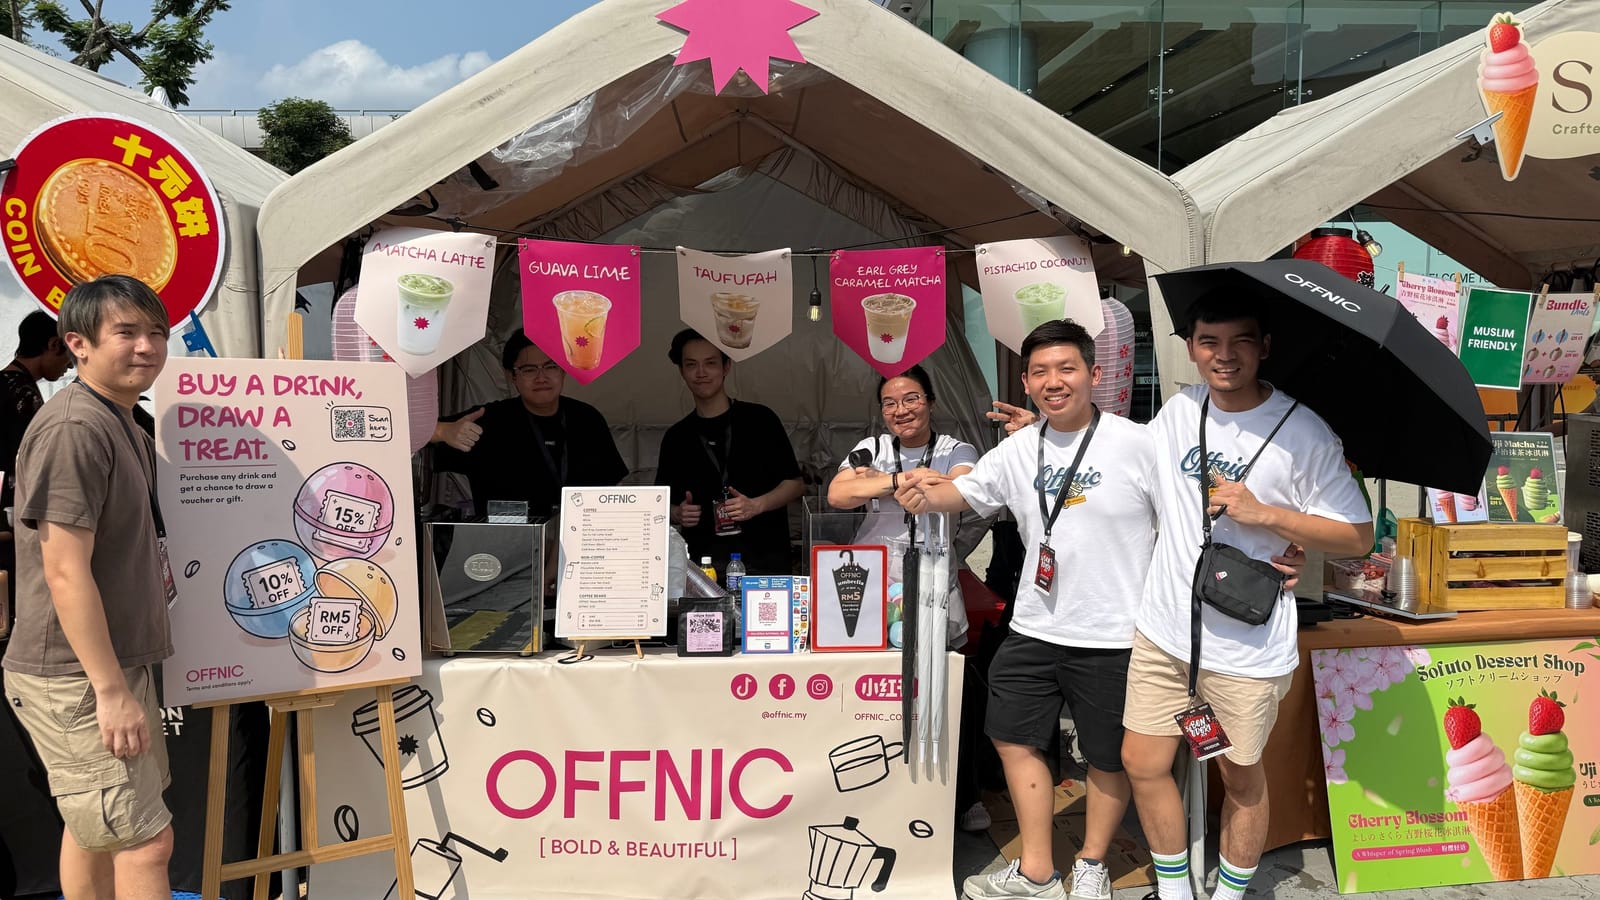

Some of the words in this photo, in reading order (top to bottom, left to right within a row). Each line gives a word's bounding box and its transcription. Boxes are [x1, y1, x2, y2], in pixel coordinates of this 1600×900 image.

[5, 197, 42, 277] COIN
[372, 242, 437, 262] MATCHA
[441, 253, 486, 269] LATTE
[528, 260, 579, 278] GUAVA
[583, 265, 631, 281] LIME
[856, 266, 886, 276] EARL
[889, 264, 918, 276] GREY
[984, 261, 1037, 276] PISTACHIO
[1040, 257, 1088, 269] COCONUT
[693, 266, 778, 287] TAUFUFAH
[834, 276, 891, 289] CARAMEL
[894, 275, 941, 288] MATCHA
[1284, 273, 1361, 313] OFFNIC
[1546, 299, 1588, 311] Bundle
[1473, 326, 1515, 339] MUSLIM
[1467, 338, 1517, 352] FRIENDLY
[177, 373, 237, 396] BUY
[245, 374, 265, 396] A
[273, 374, 363, 400] DRINK,
[178, 405, 263, 428] DRAW
[272, 406, 292, 427] A
[368, 414, 389, 422] Scan
[369, 423, 387, 431] here
[179, 438, 268, 461] TREAT.
[1504, 440, 1536, 448] Matcha
[179, 473, 219, 482] Purchase
[220, 474, 237, 483] any
[238, 472, 258, 480] drink
[259, 471, 277, 479] and
[180, 484, 194, 493] get
[203, 483, 233, 491] chance
[235, 483, 244, 491] to
[245, 482, 266, 490] draw
[180, 496, 214, 504] voucher
[227, 494, 244, 504] gift.
[598, 494, 637, 504] OFFNIC
[334, 506, 365, 526] 15%
[335, 523, 357, 533] OFF
[259, 572, 293, 594] 10%
[837, 579, 864, 587] umbrella
[268, 589, 290, 603] OFF
[841, 591, 861, 601] RM5
[320, 610, 351, 625] RM5
[322, 625, 344, 635] OFF
[186, 664, 244, 682] OFFNIC
[1416, 657, 1472, 683] Sofuto
[1475, 653, 1539, 671] Dessert
[1543, 653, 1585, 677] Shop
[1445, 672, 1563, 691] ソフトクリームショップ
[761, 710, 807, 721] @offnic.my
[1579, 762, 1597, 779] Uji
[486, 748, 794, 821] OFFNIC
[1348, 813, 1402, 830] Cherry
[1405, 810, 1468, 825] Blossom
[551, 839, 602, 855] BOLD
[607, 840, 620, 855] &
[626, 840, 727, 858] BEAUTIFUL
[1395, 847, 1416, 858] Spring
